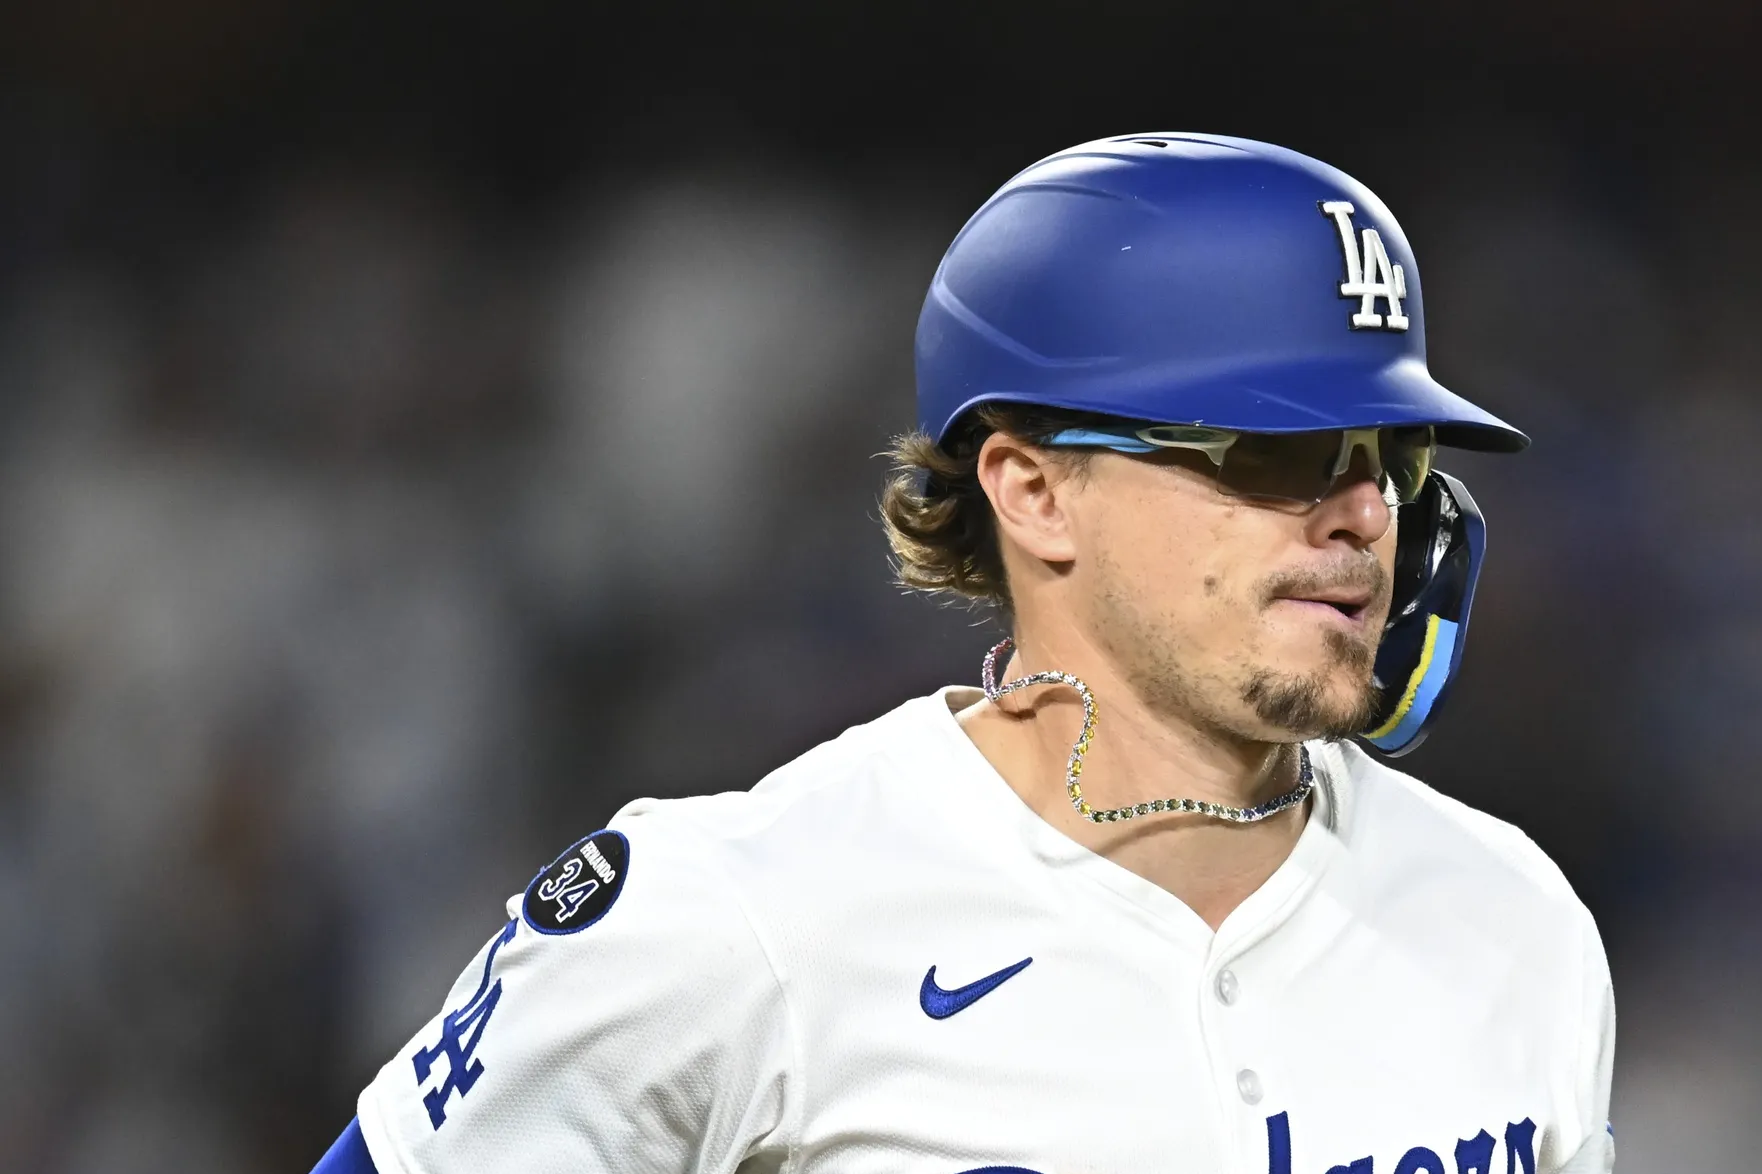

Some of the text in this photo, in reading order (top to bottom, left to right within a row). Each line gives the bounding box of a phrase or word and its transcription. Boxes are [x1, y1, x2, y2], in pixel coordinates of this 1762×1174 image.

[1319, 200, 1410, 331] LA
[538, 857, 600, 923] 34
[579, 840, 616, 884] FERNANDO
[412, 916, 520, 1132] LA
